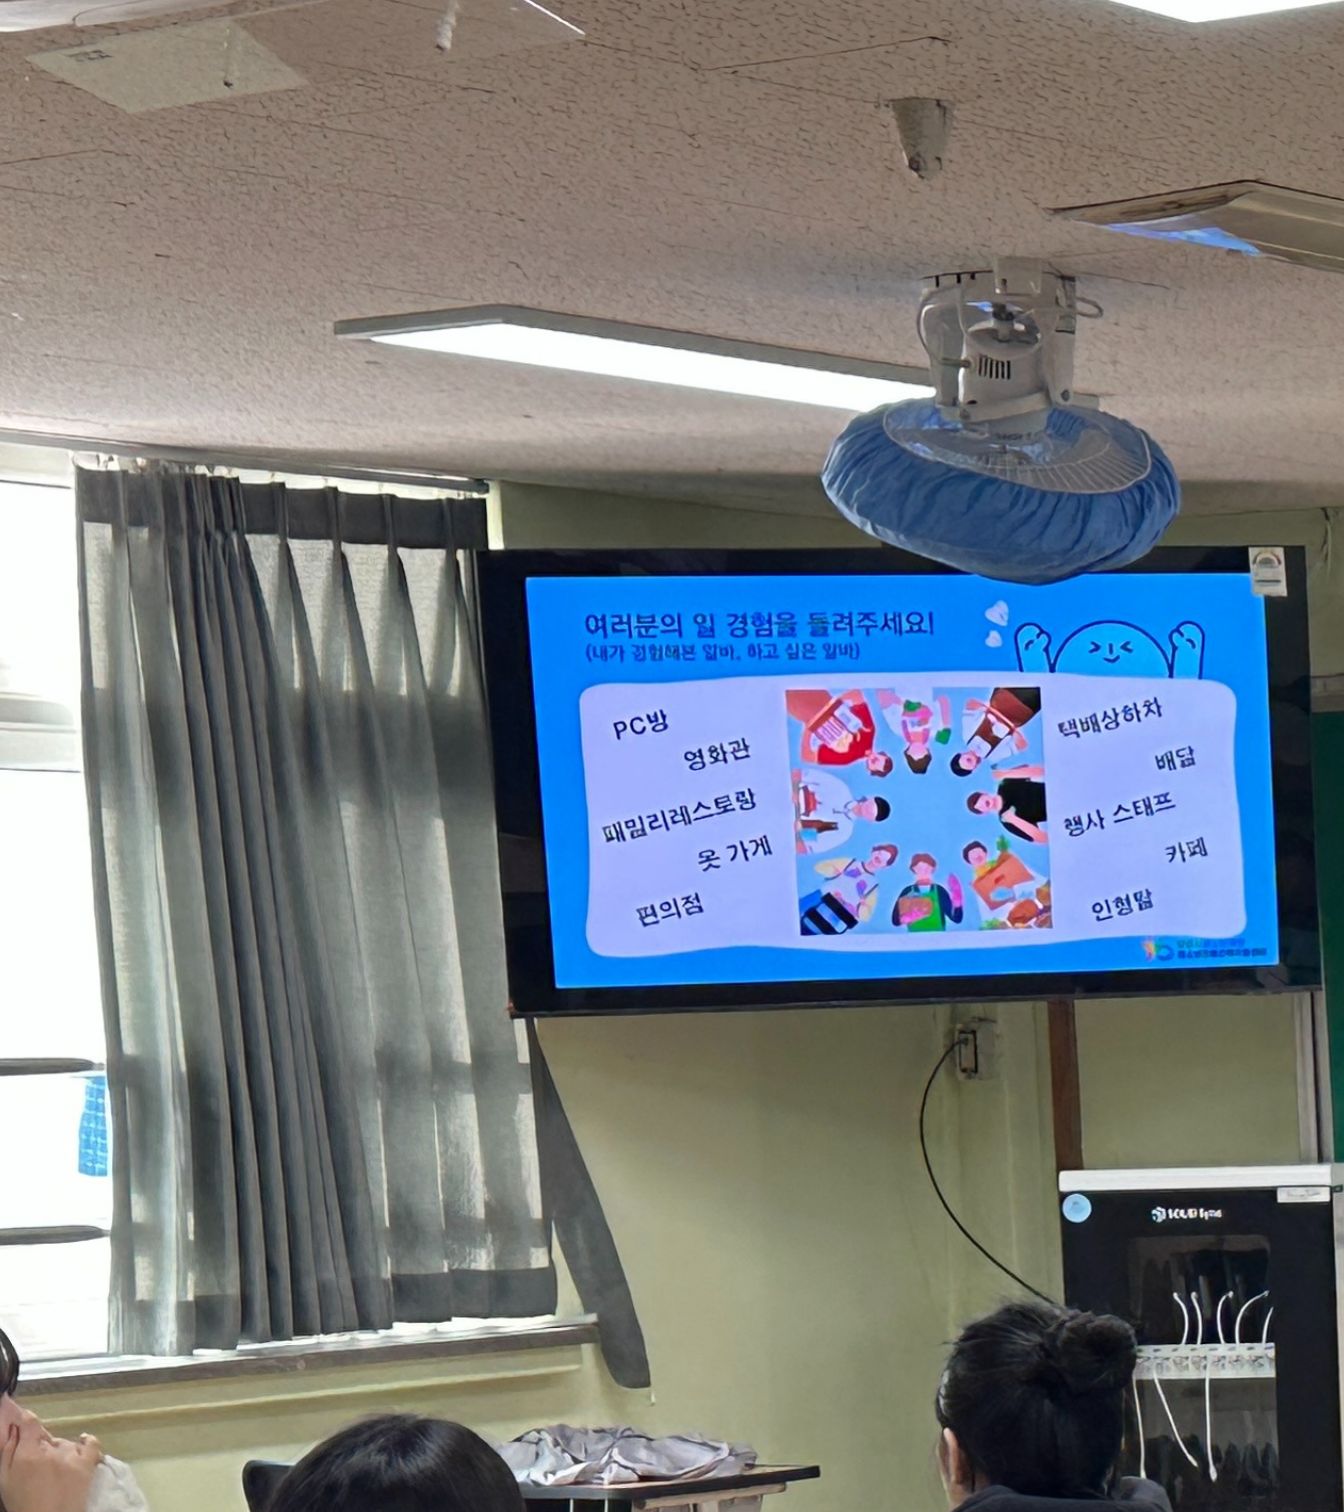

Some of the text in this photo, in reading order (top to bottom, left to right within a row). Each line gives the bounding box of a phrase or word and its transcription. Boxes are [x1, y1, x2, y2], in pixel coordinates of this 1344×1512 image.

[585, 611, 934, 639] 여러분의 일 경험을 들려주세요!
[613, 709, 668, 740] PC방
[1057, 696, 1163, 738] 택배상하차
[684, 738, 750, 771] 영화관
[1155, 745, 1196, 771] 배달
[602, 788, 757, 842] 패밀리레스토랑
[1064, 791, 1176, 837] 행사 스태프
[698, 835, 773, 872] 옷 가게
[1165, 836, 1208, 863] 카페
[636, 892, 704, 927] 편의점
[1092, 888, 1153, 922] 인형탈
